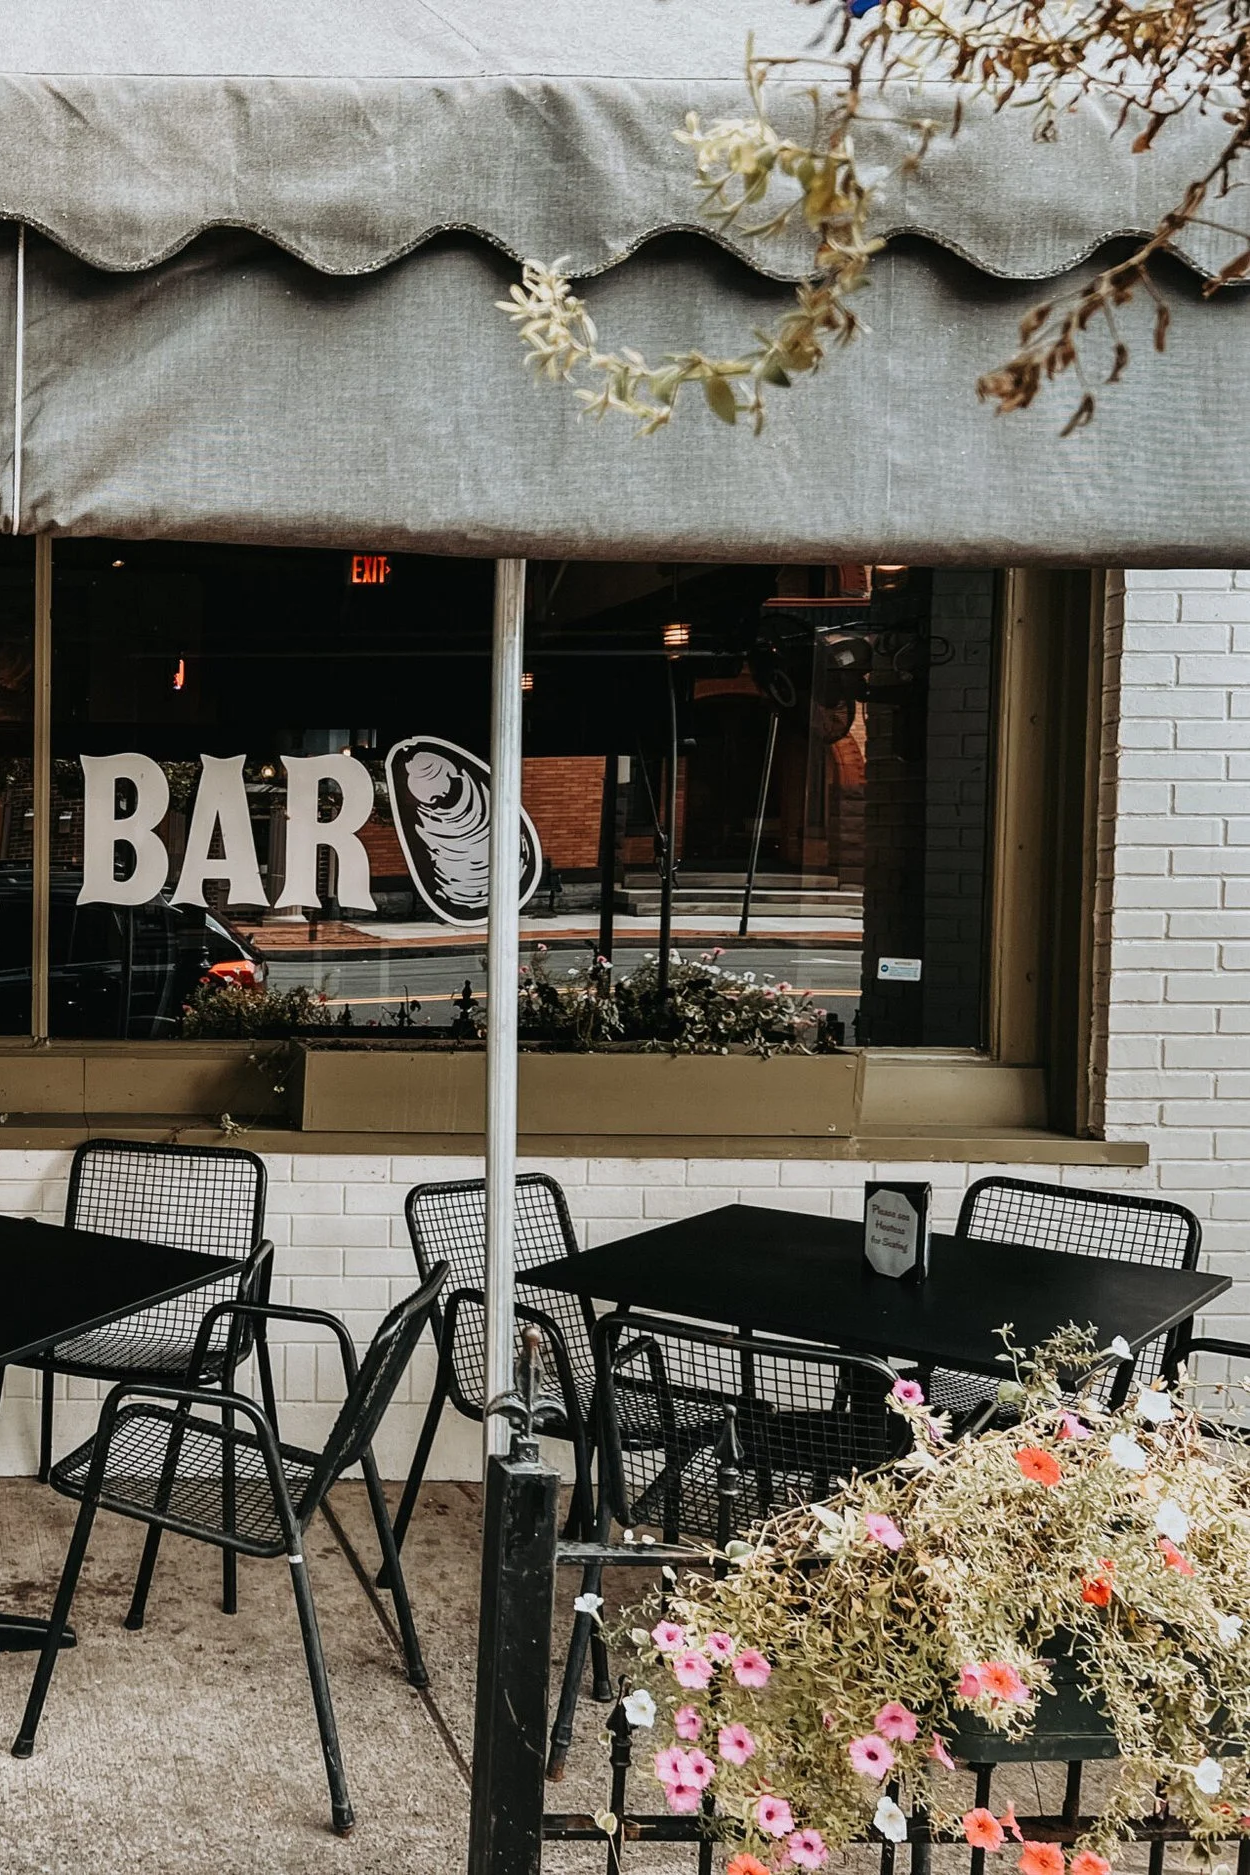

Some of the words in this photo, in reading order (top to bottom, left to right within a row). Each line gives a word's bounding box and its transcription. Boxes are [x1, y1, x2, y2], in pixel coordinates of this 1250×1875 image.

[352, 555, 387, 583] EXIT
[77, 753, 377, 911] BAR
[872, 1204, 896, 1218] Please
[897, 1213, 910, 1222] see
[875, 1219, 905, 1235] Hostess
[882, 1237, 908, 1254] Seating
